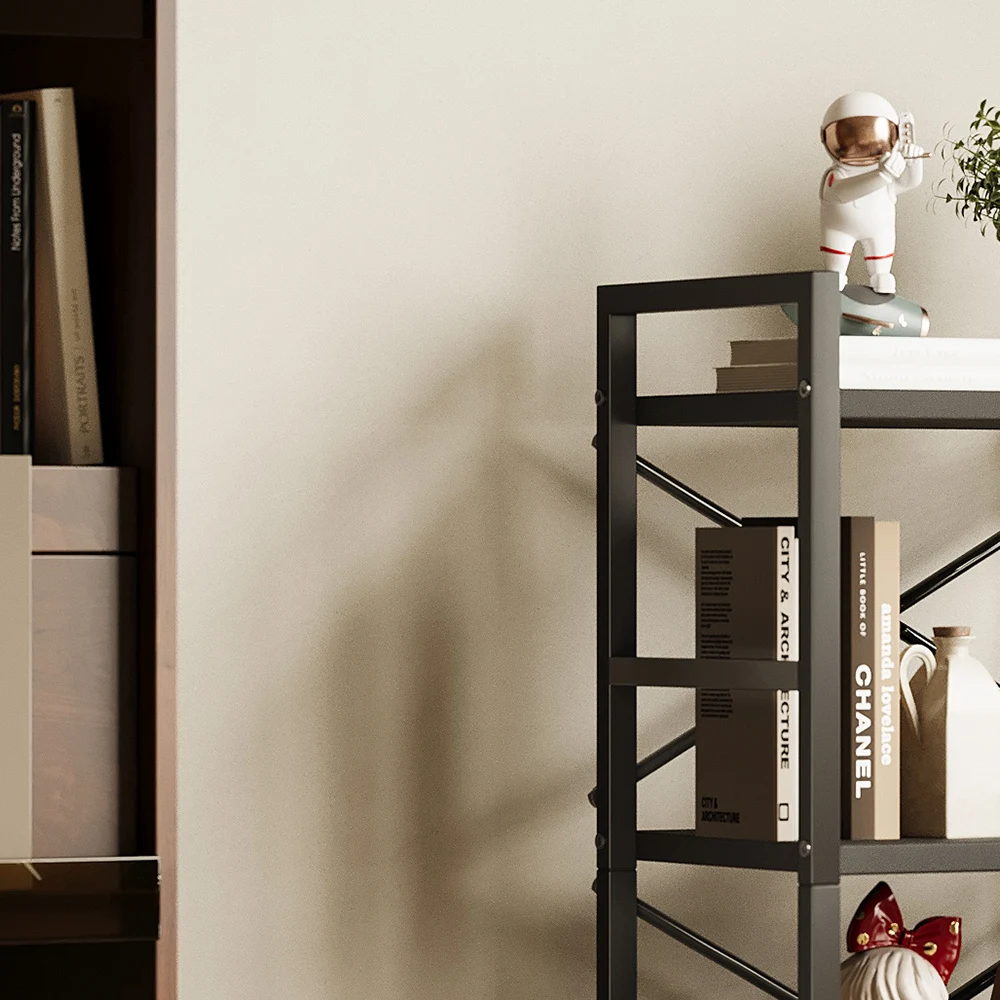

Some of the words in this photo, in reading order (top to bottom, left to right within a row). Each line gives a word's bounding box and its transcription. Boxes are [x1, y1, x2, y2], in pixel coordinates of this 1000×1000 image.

[781, 537, 790, 582] CITY
[781, 590, 790, 603] &
[860, 622, 866, 638] OF
[881, 602, 894, 680] amanda
[855, 664, 872, 799] CHANEL
[881, 685, 894, 766] lovelace
